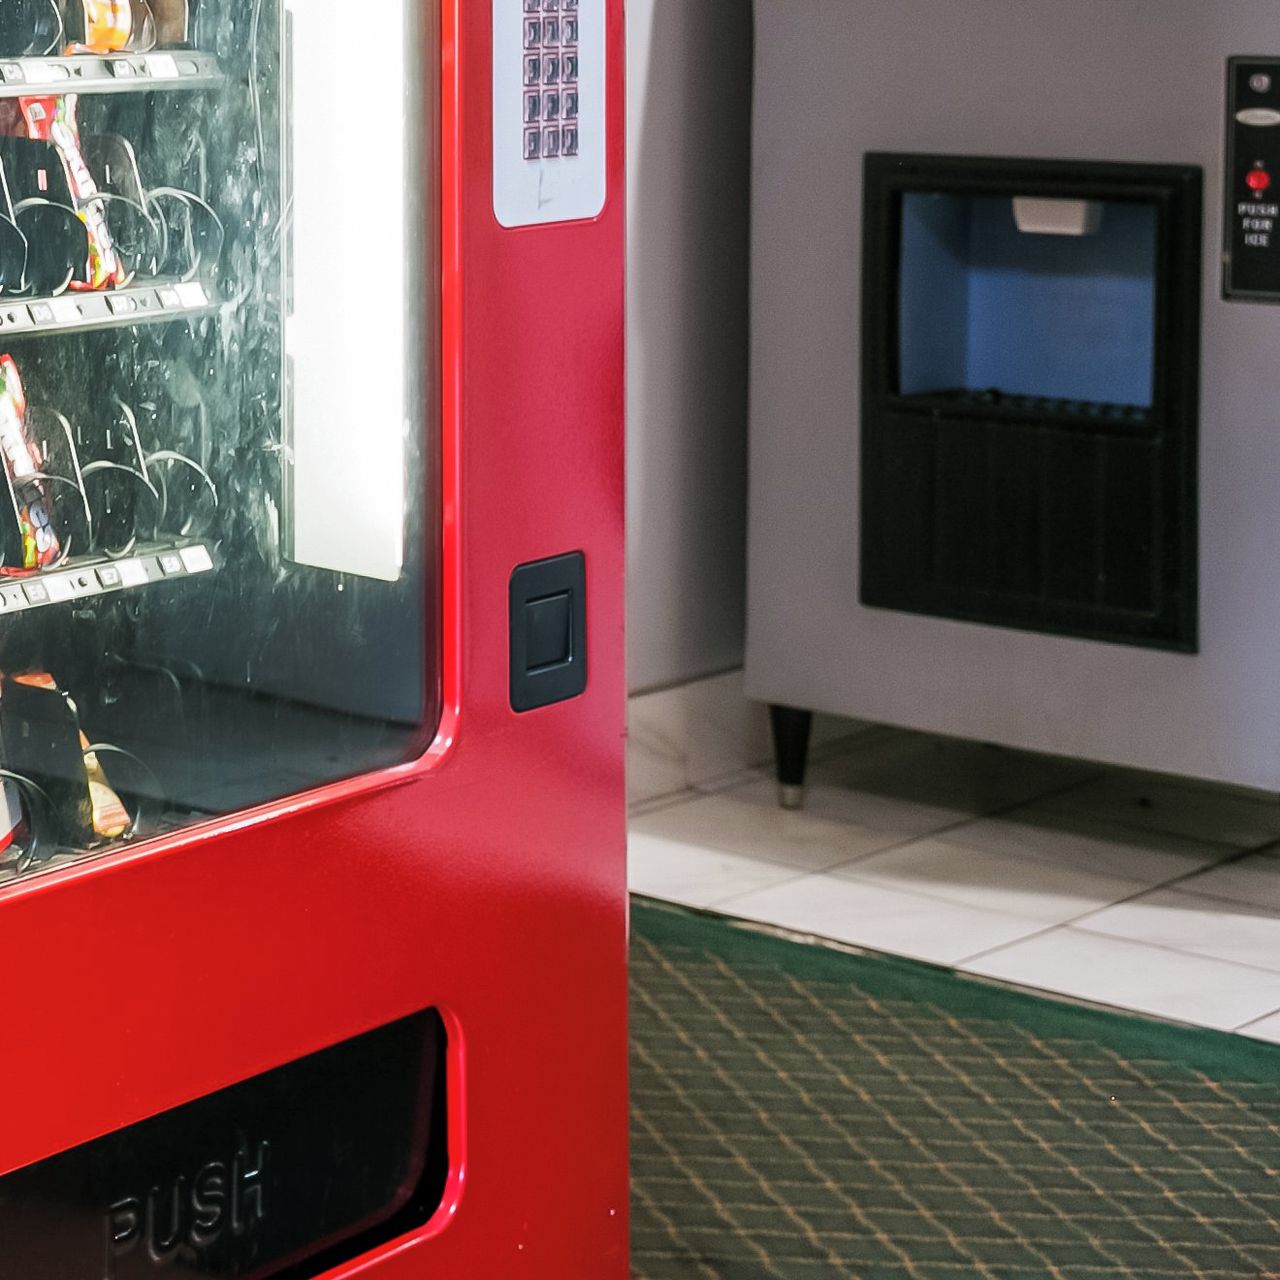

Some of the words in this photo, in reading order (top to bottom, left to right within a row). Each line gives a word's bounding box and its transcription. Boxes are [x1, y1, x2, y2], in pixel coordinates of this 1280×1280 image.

[1237, 202, 1279, 218] PUSH
[1242, 217, 1273, 231] FOR
[1244, 233, 1270, 247] ICE
[102, 1137, 269, 1279] PUSH
